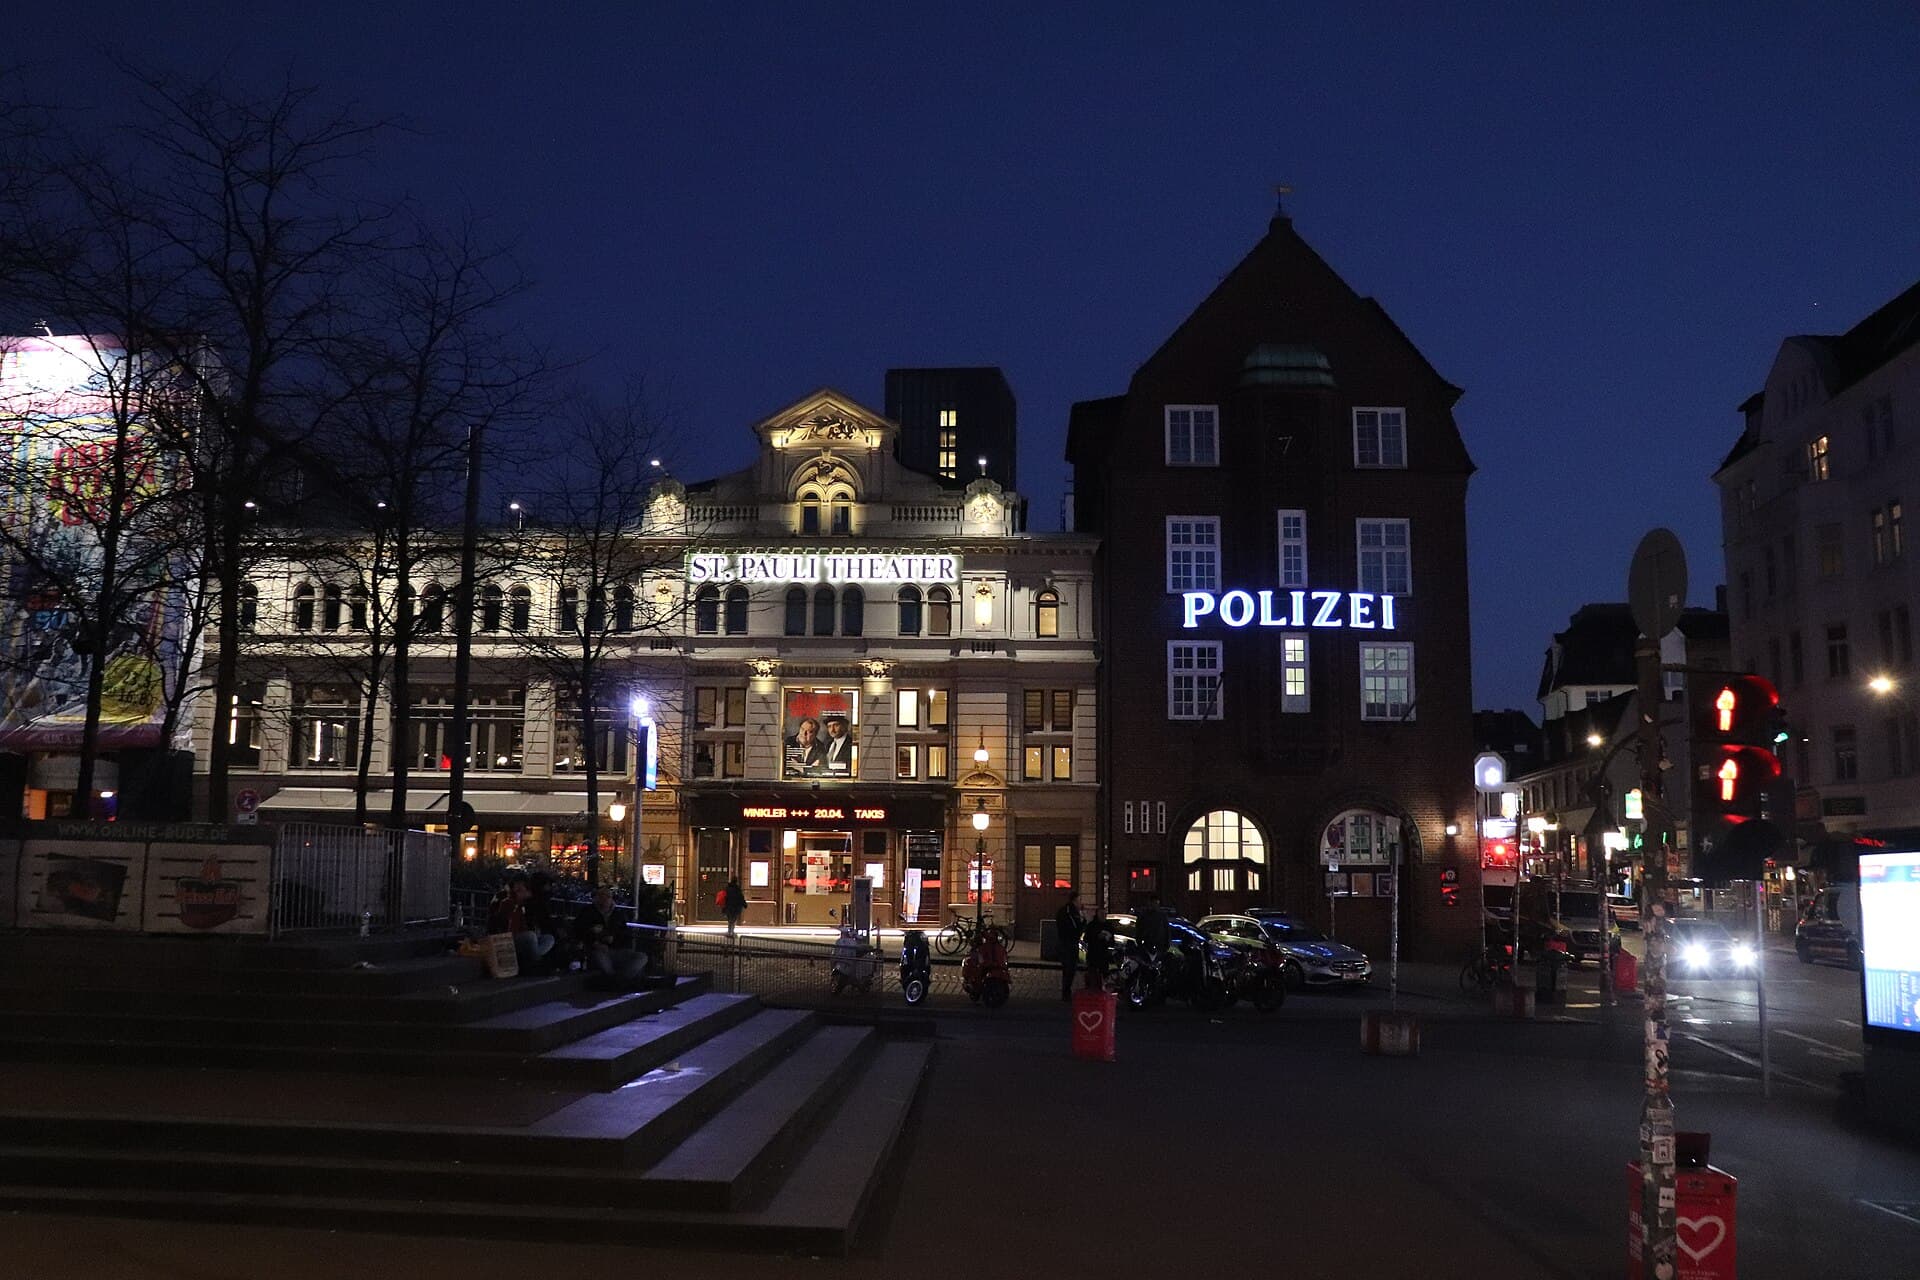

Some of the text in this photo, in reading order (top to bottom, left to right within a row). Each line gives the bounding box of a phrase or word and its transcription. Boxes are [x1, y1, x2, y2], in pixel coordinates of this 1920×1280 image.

[692, 557, 955, 580] ST. PAULI THEATER
[1181, 589, 1396, 631] POLIZEI
[814, 809, 845, 819] 20.04.
[854, 809, 885, 819] TAKIS
